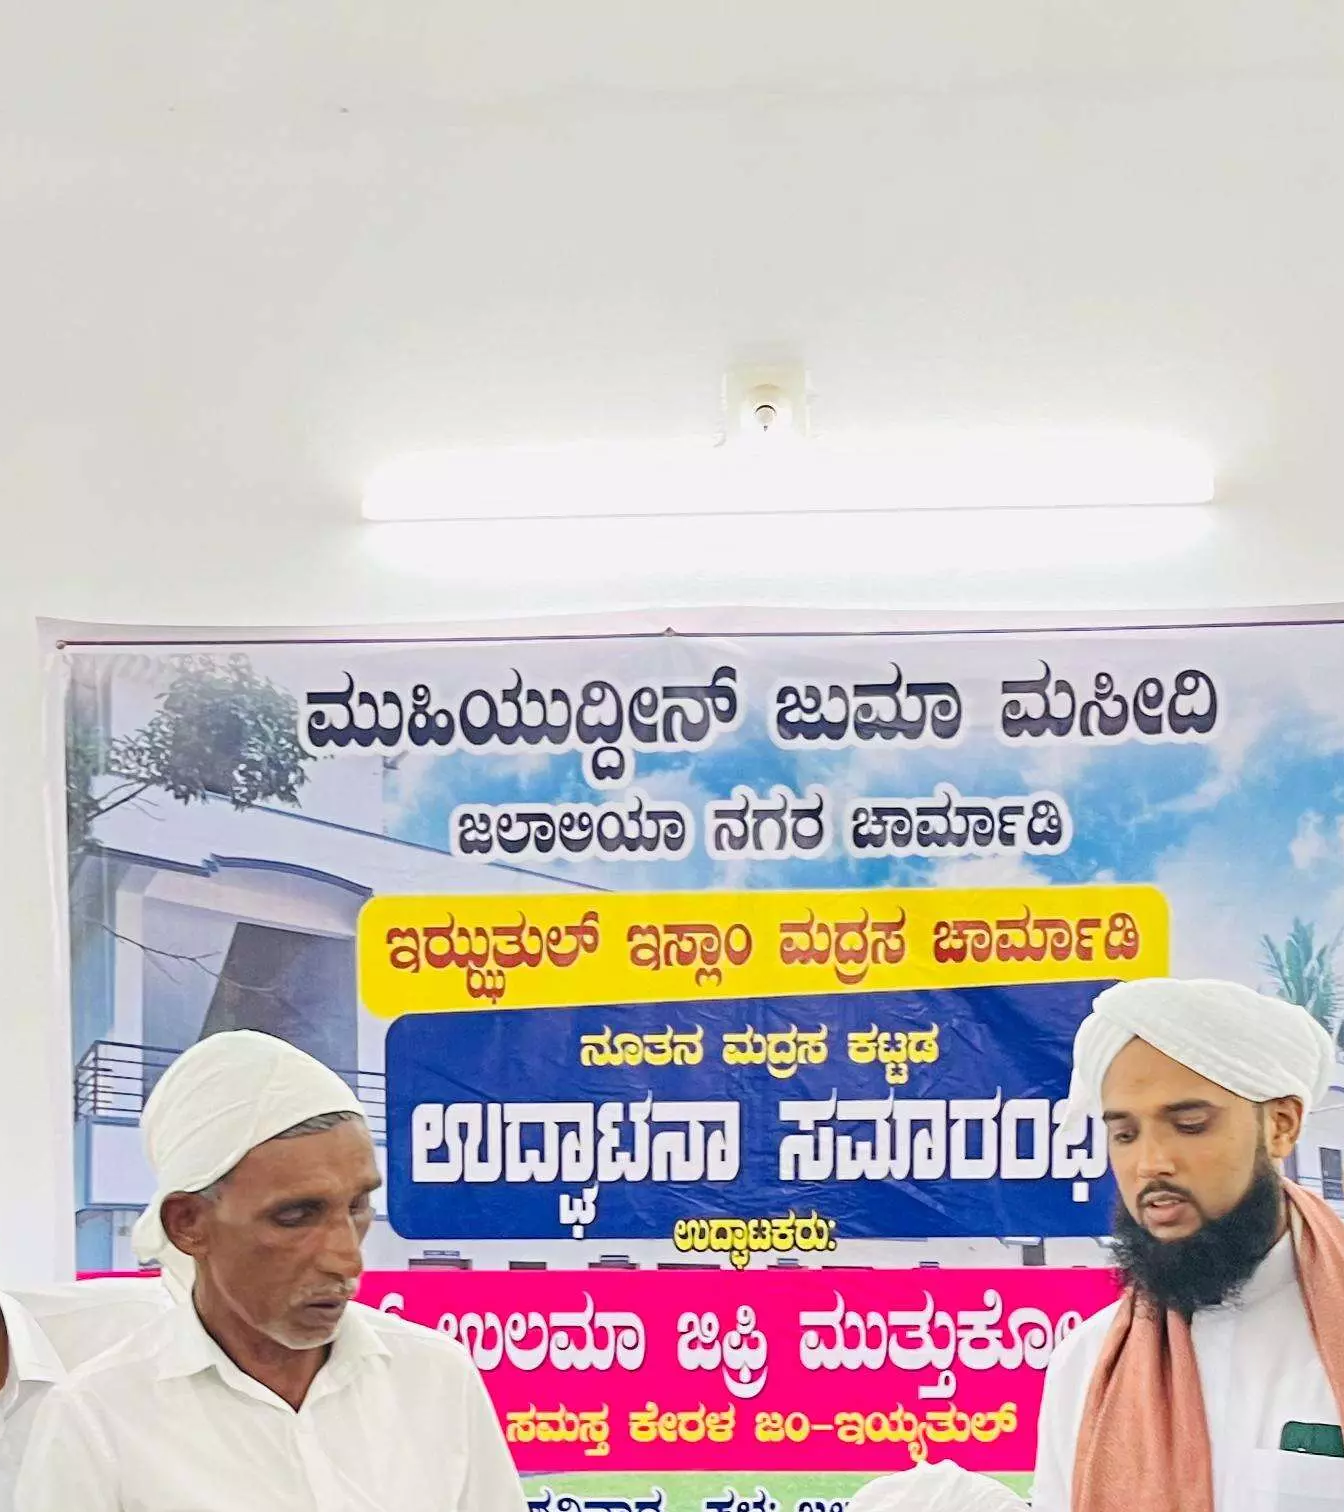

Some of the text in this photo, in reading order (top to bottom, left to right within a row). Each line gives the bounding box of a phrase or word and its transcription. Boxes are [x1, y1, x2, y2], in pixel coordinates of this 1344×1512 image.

[306, 659, 1218, 780] ಮುಹಿಯುದ್ದೀನ್ ಜುಮಾ ಮಸೀದಿ
[459, 791, 1062, 853] ಜಲಾಲಿಯಾ ನಗರ ಚಾರ್ಮಾಡಿ
[386, 903, 1140, 1004] ಇಝ್ಝತುಲ್ ಇಸ್ಲಾಂ ಮದ್ರಸ ಚಾರ್ಮಾಡಿ
[580, 1022, 940, 1084] ನೂತನ ಮದ್ರಸ ಕಟ್ಟಡ
[411, 1088, 741, 1239] ಉದ್ಘಾಟನಾ
[673, 1209, 837, 1269] ಉದ್ಘಾಟಕರು:
[677, 1304, 767, 1398] ಜಿಫ್ರಿ
[507, 1402, 609, 1456] ಸಮಸ್ತ
[629, 1401, 735, 1442] ಕೇರಳ
